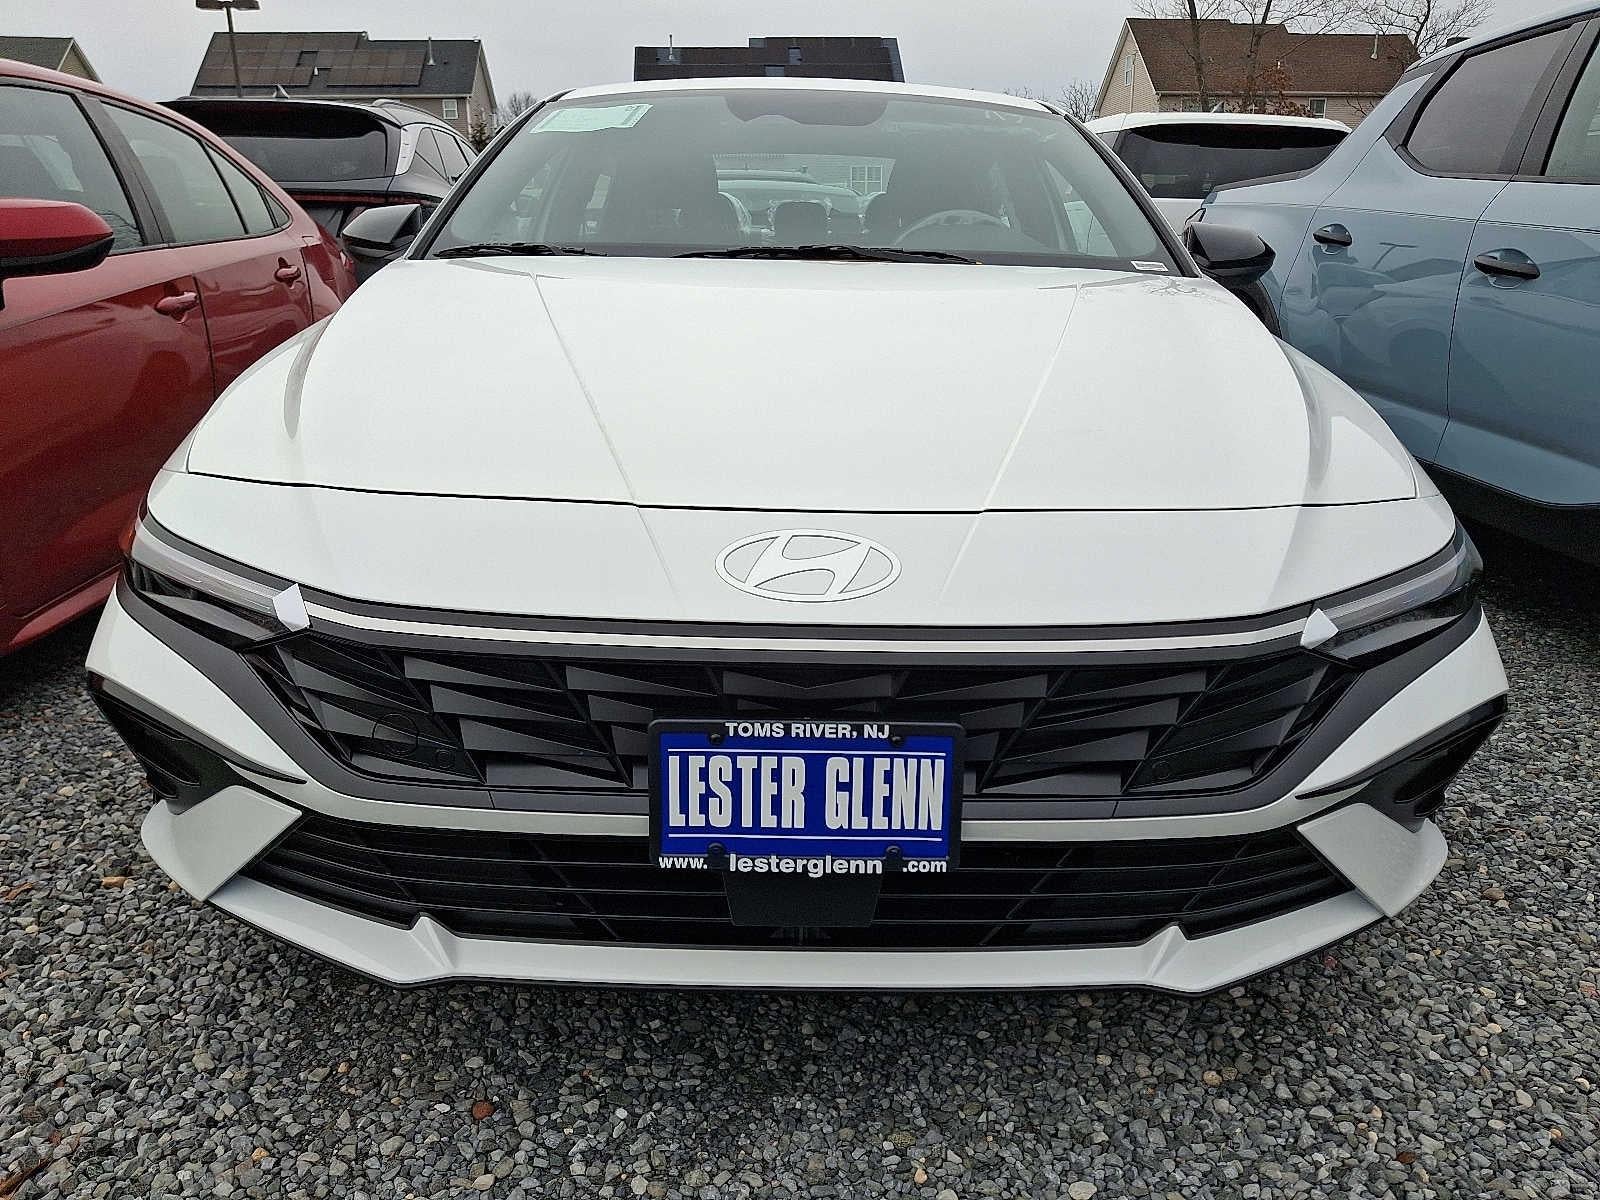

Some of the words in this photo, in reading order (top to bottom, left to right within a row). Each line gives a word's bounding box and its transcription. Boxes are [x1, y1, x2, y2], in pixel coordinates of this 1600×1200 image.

[725, 722, 785, 738] TOMS
[791, 723, 858, 739] RIVER,
[864, 724, 890, 740] NJ
[668, 755, 806, 828] LESTER
[825, 756, 945, 831] GLENN
[659, 856, 708, 869] www.
[729, 853, 883, 878] lesterglenn
[902, 859, 947, 873] .com
